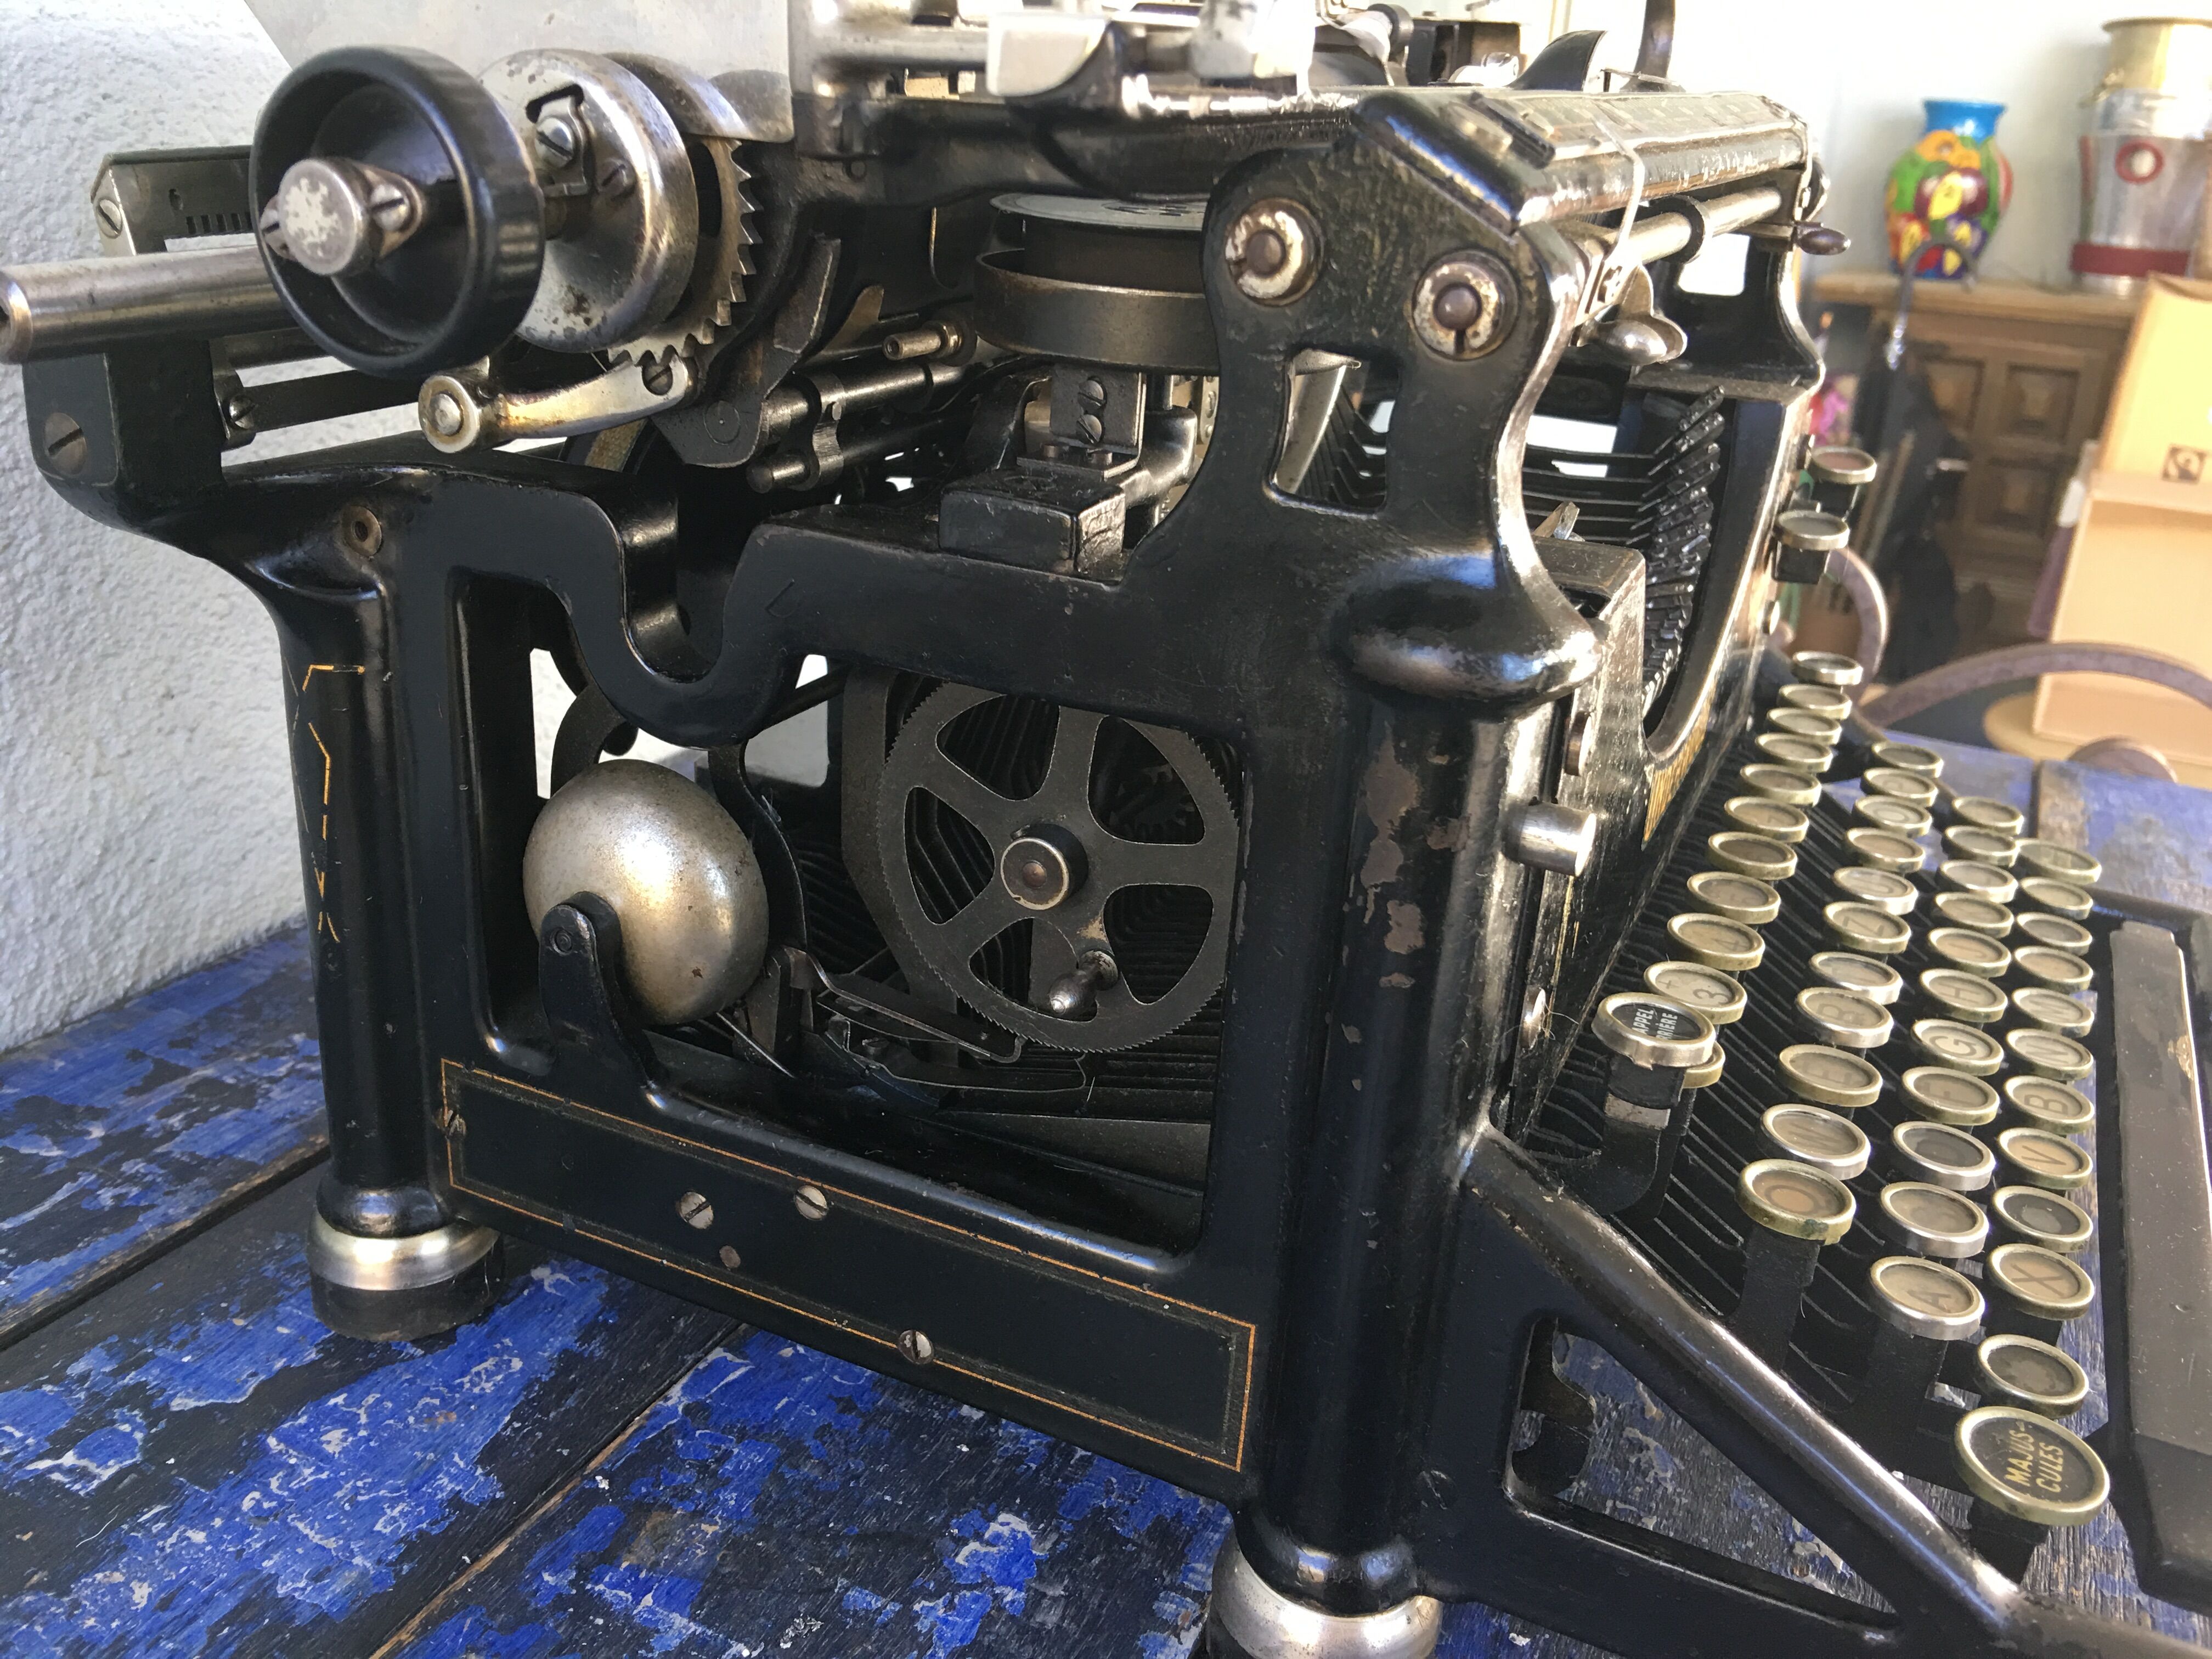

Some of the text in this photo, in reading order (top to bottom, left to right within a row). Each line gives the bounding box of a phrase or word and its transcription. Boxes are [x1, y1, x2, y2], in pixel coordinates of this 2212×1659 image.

[1842, 916, 1885, 937] Z
[1692, 988, 1729, 1005] 3
[1938, 982, 1983, 1004] H
[1632, 1008, 1654, 1035] APPEL
[1655, 1012, 1678, 1039] RRIÈRE
[1928, 1035, 1978, 1057] G
[2026, 1042, 2069, 1064] N
[1923, 1081, 1972, 1107] F
[2023, 1093, 2069, 1115] B
[2021, 1144, 2067, 1166] V
[2011, 1263, 2066, 1297] X
[1906, 1289, 1952, 1313] A
[2004, 1421, 2035, 1487] MAJUS-
[2035, 1442, 2064, 1493] CULES
